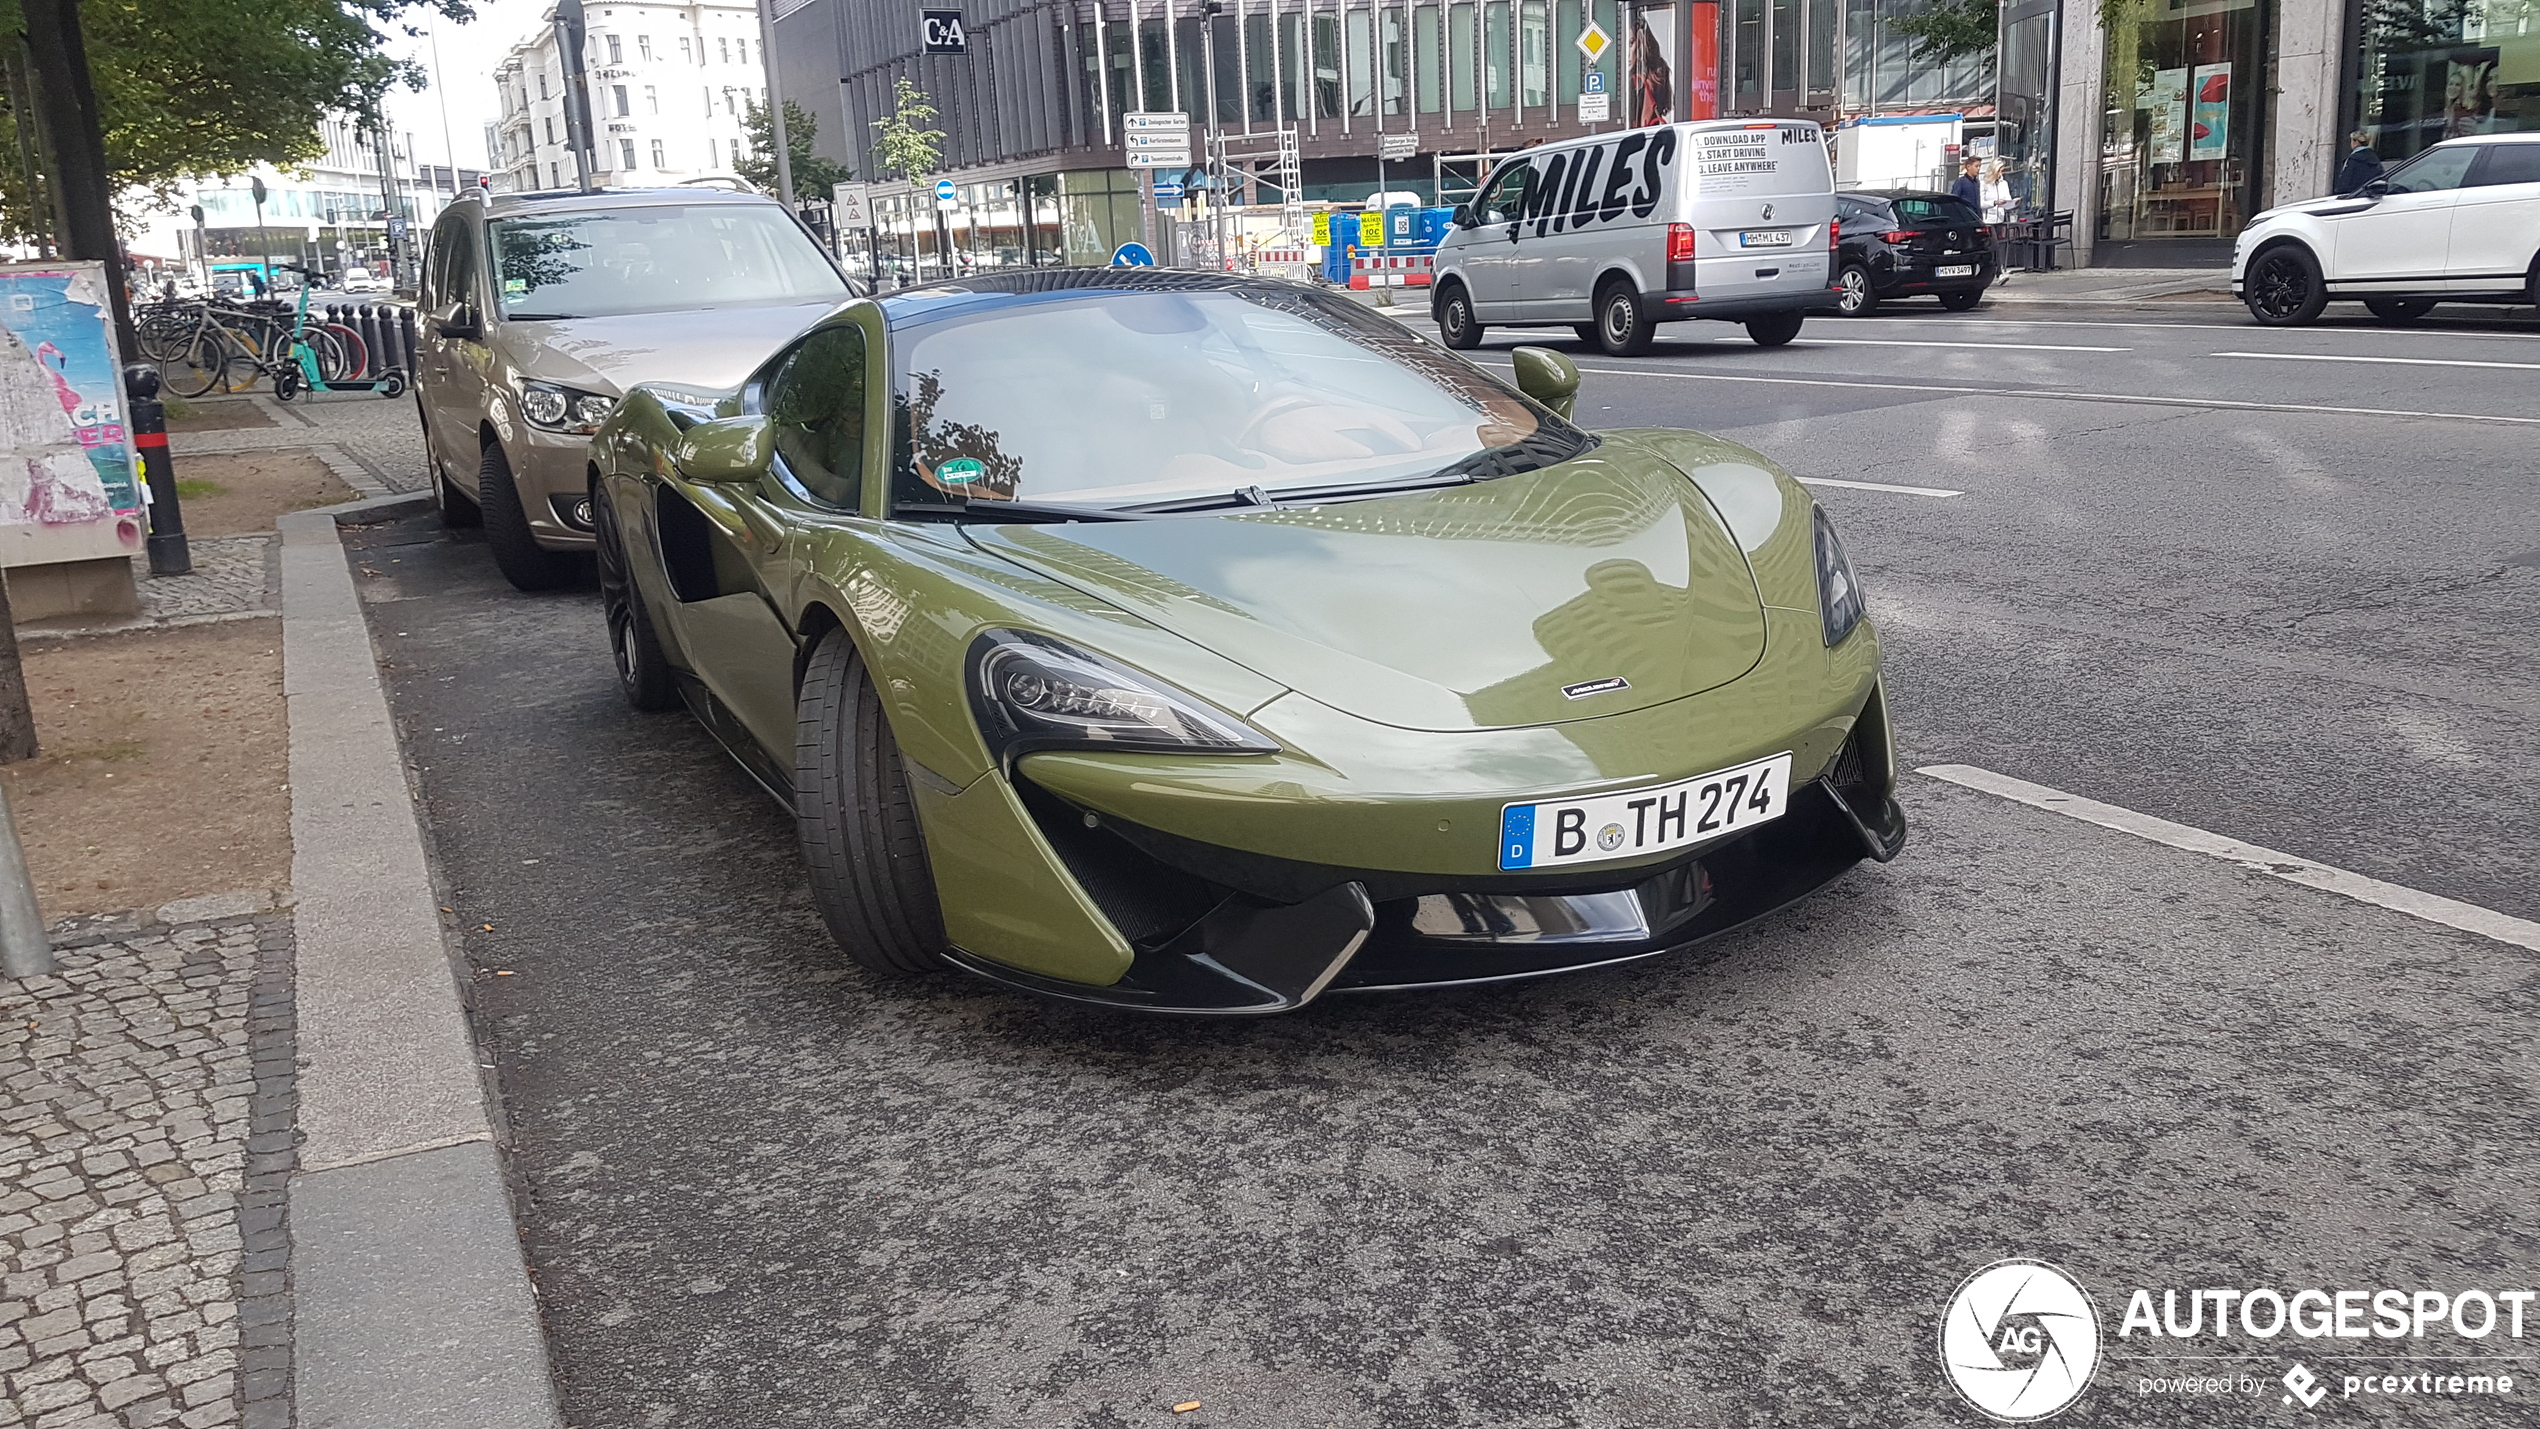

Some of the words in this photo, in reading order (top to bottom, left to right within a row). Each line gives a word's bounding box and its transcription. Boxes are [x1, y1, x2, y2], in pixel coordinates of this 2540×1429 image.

[923, 18, 965, 46] C&A
[1589, 75, 1600, 91] P
[1703, 134, 1749, 146] DOWNLOAD
[1750, 134, 1766, 144] APP
[1781, 129, 1818, 145] MILES
[1697, 150, 1706, 160] 2.
[1706, 149, 1732, 160] START
[1733, 148, 1766, 158] DRIVING
[1698, 165, 1707, 174] 3.
[1708, 162, 1733, 173] LEAVE
[1510, 126, 1677, 244] MILES
[1746, 235, 1758, 243] HH
[1762, 233, 1774, 242] MI
[1775, 233, 1790, 242] 437
[1510, 844, 1523, 858] D
[1554, 808, 1587, 857] B
[1627, 790, 1687, 847] TH
[1697, 768, 1772, 834] 274
